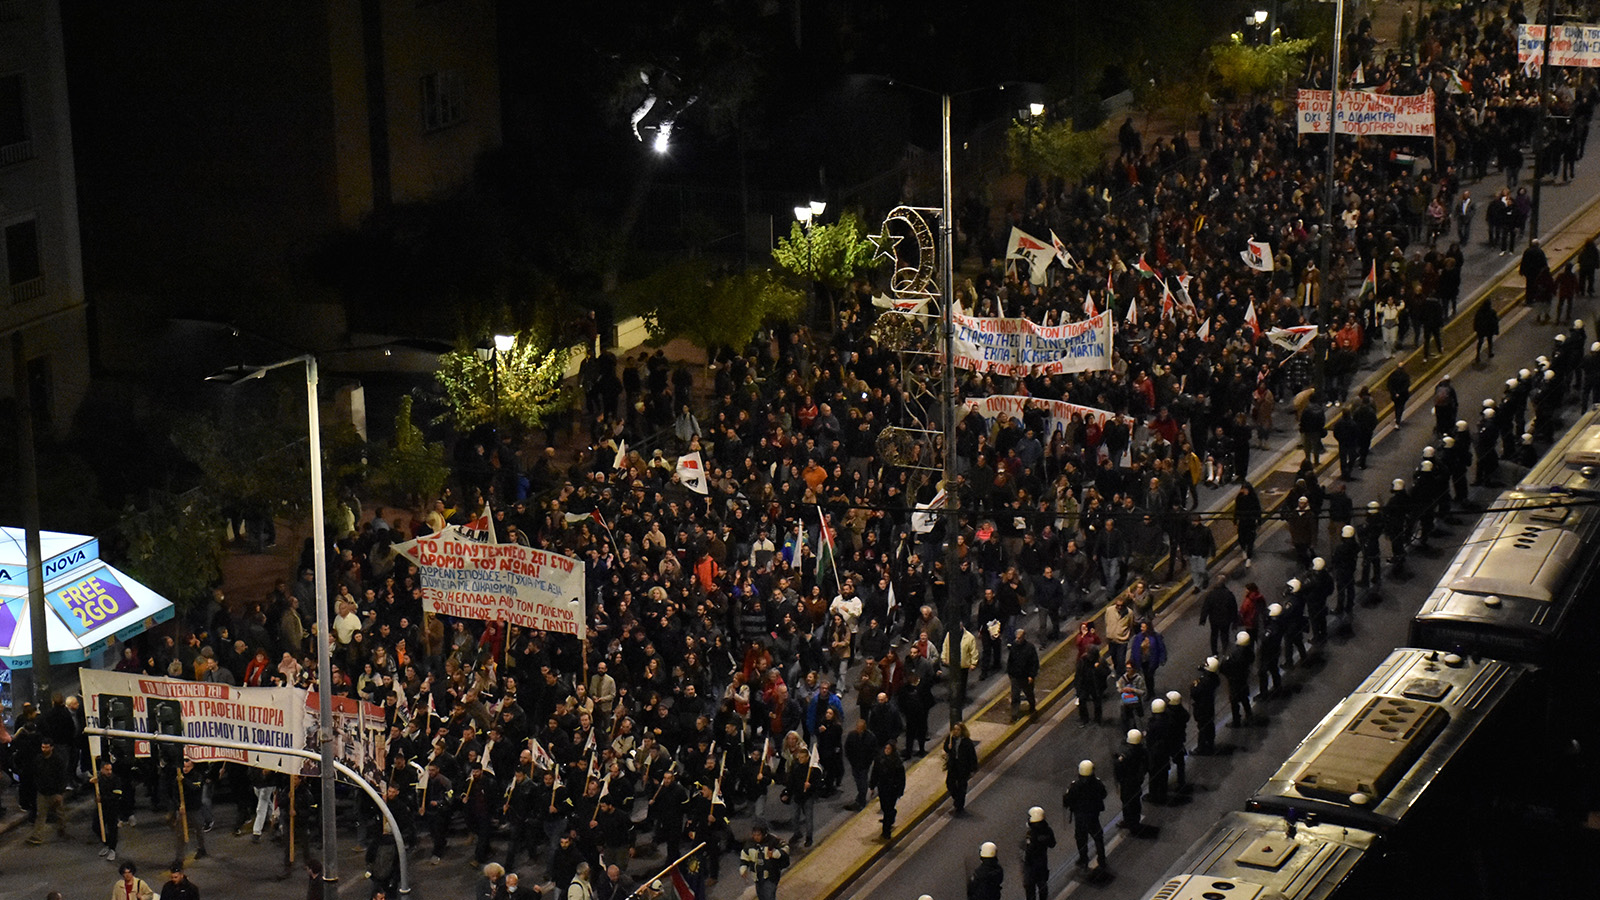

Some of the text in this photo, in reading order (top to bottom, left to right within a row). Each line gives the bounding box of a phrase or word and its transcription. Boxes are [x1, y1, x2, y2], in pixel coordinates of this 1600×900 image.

[1348, 101, 1366, 112] ΤΟΥ
[1349, 111, 1395, 123] ΔΙΔΑΚΤΡΑ
[980, 319, 1018, 334] ΕΛΛΑΔΑ
[1040, 327, 1060, 339] ΤΟΝ
[1069, 343, 1105, 359] MARTIN
[45, 550, 86, 577] NOVA
[417, 539, 439, 554] ΤΟ
[531, 550, 547, 566] ΖΕΙ
[551, 555, 575, 574] ΣΤΟΝ
[420, 553, 540, 579] ΔΡΟΜΟ ΤΟΥ ΑΓΩΝΑ!
[420, 565, 457, 580] ΔΩΡΕΑΝ
[457, 569, 502, 583] ΣΠΟΥΔΕΣ
[534, 579, 547, 592] ΜΕ
[457, 580, 471, 592] ΜΕ
[57, 575, 107, 611] FREE
[456, 592, 497, 606] ΕΛΛΑΔΑ
[516, 599, 534, 613] ΤΟΝ
[73, 594, 119, 630] 2GO
[433, 600, 492, 620] ΦΟΙΤΗΤΙΚΟΣ
[144, 681, 156, 694] ΤΟ
[155, 683, 206, 697] ΠΟΛΥΤΕΧΝΕΙΟ
[200, 700, 246, 722] ΓΡΑΦΕΤΑΙ
[248, 705, 285, 728] ΙΣΤΟΡΙΑ
[187, 720, 235, 741] ΠΟΛΕΜΟΥ
[237, 725, 250, 744] ΤΑ
[252, 727, 294, 750] ΣΦΑΓΕΙΑ!
